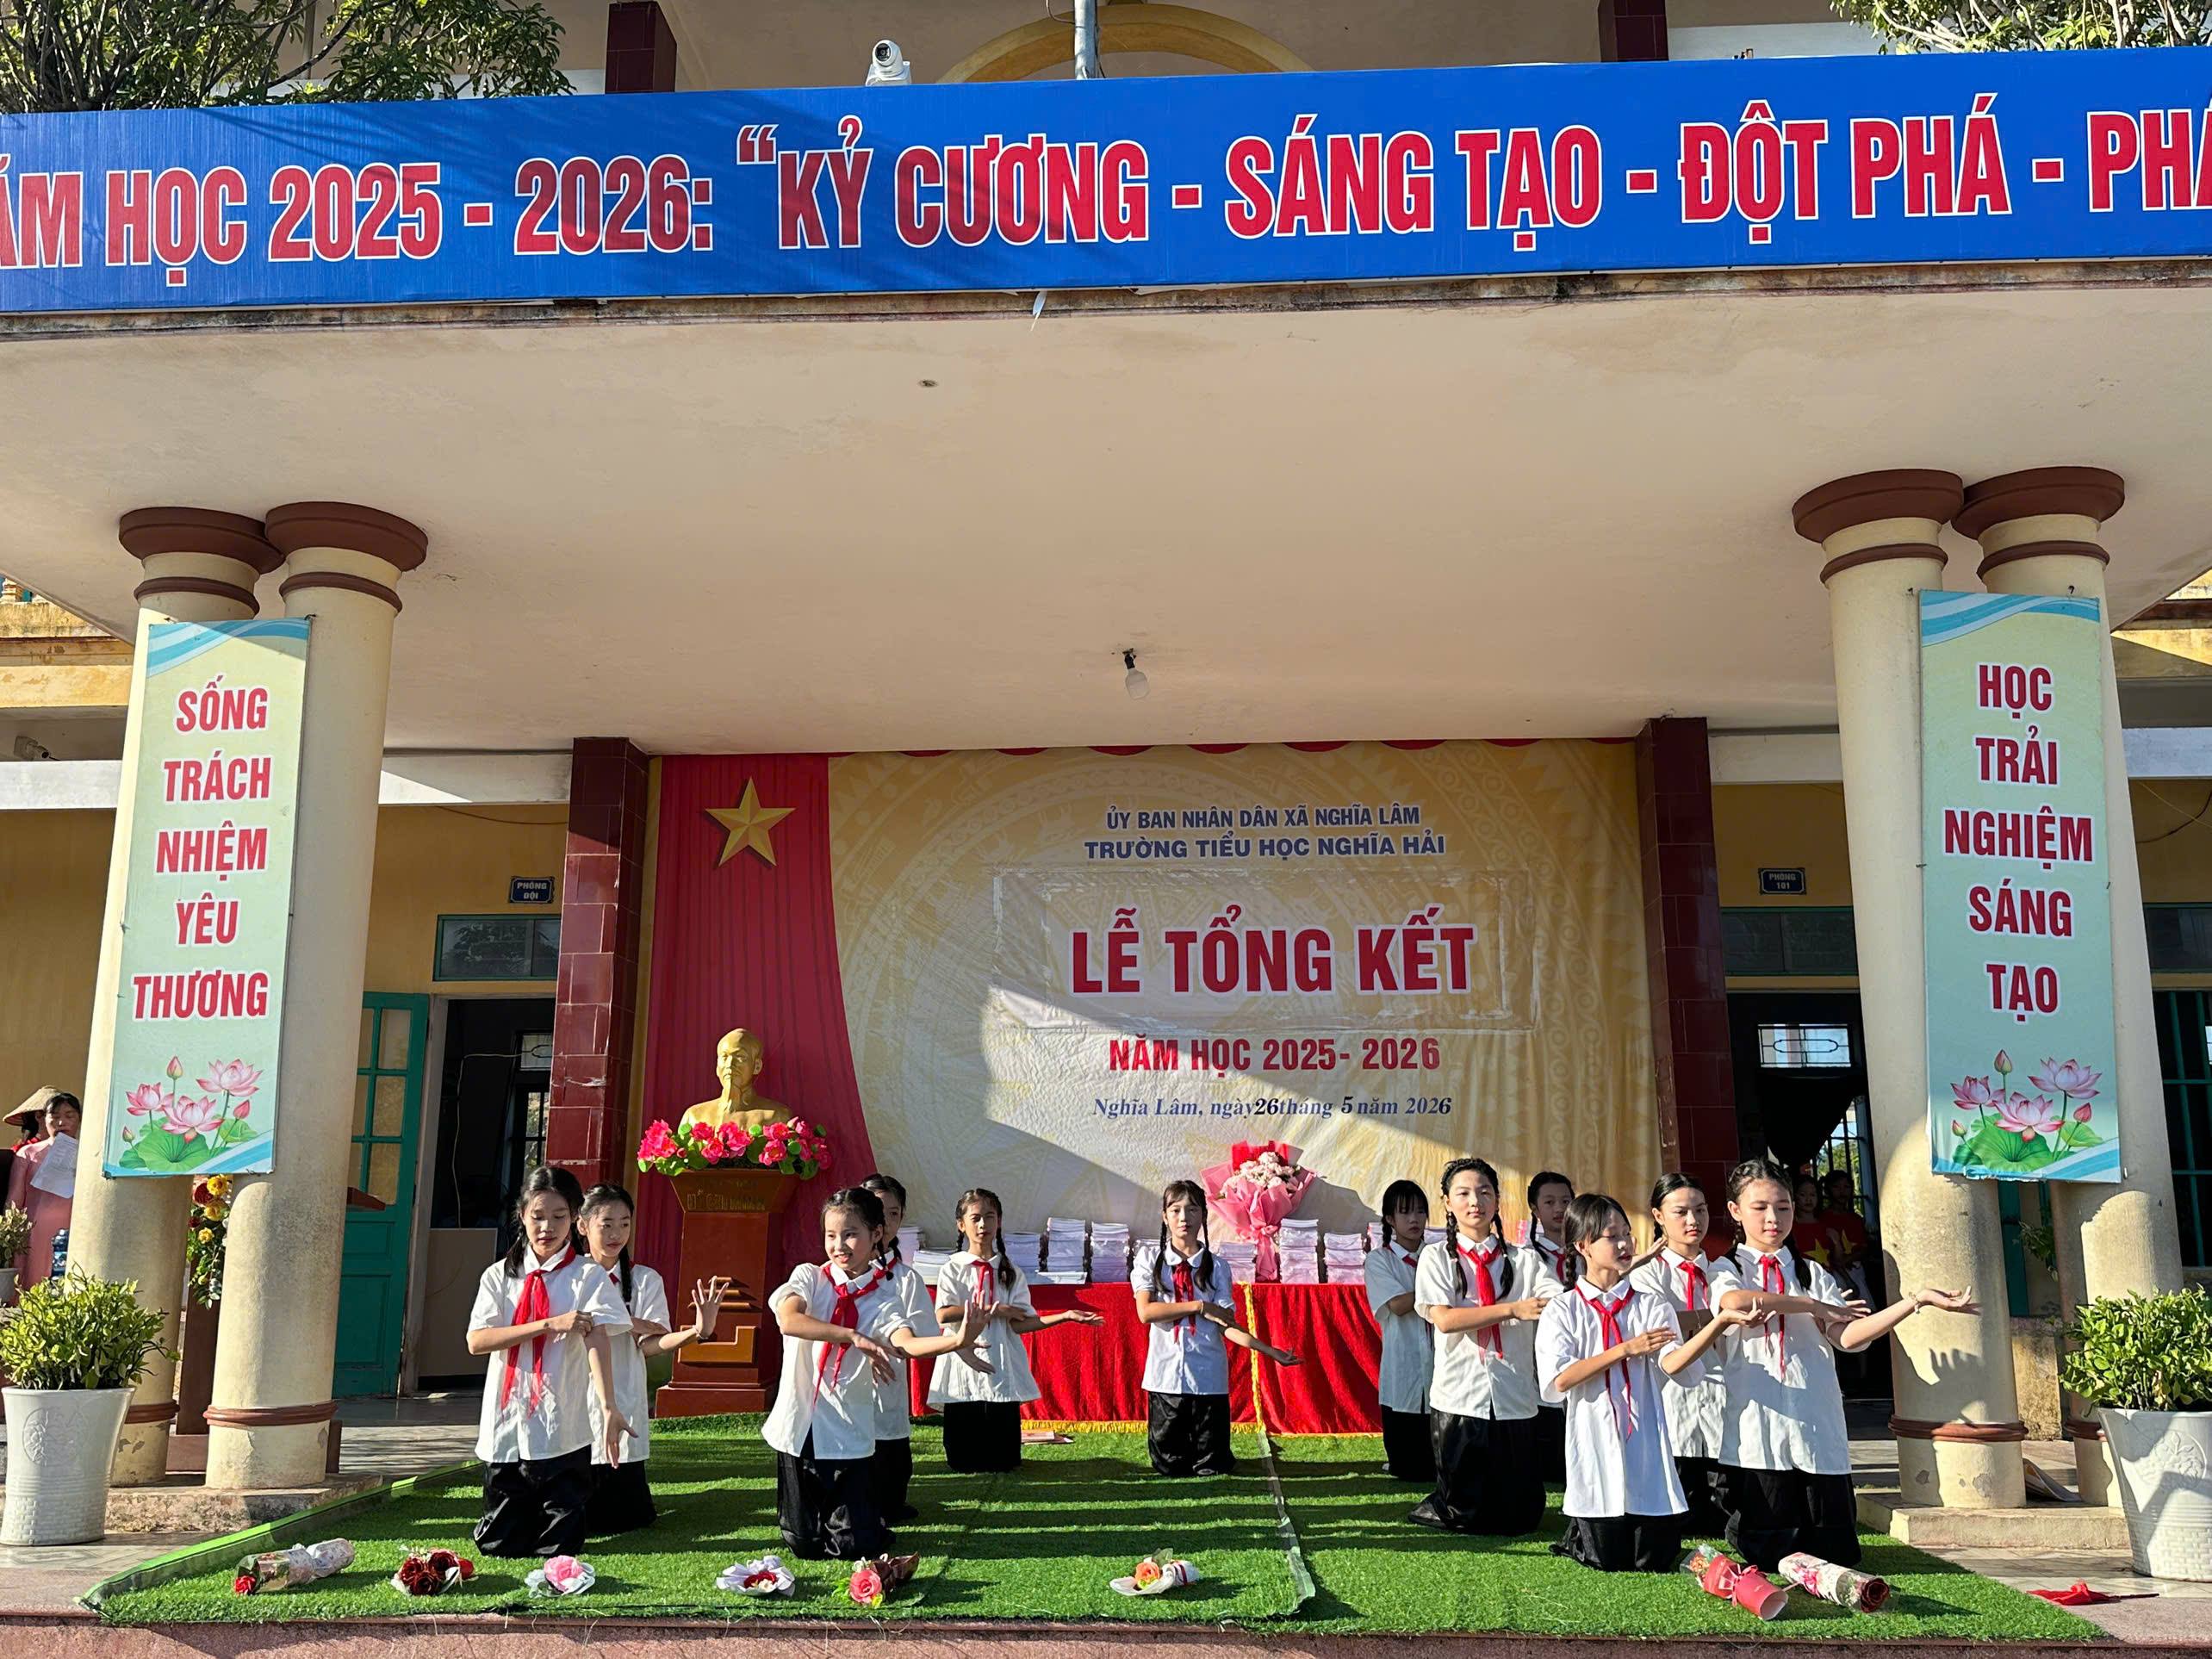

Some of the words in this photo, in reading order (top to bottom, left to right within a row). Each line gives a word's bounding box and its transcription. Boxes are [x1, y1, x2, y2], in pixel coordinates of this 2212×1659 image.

[105, 166, 247, 288] HỌC
[268, 162, 442, 262] 2025
[463, 202, 494, 227] -
[513, 155, 713, 256] 2026:
[895, 134, 1149, 249] CƯƠNG
[1171, 183, 1202, 209] -
[1225, 113, 1435, 240] SÁNG
[1455, 124, 1603, 252] TẠO
[1625, 169, 1658, 194] -
[1677, 99, 1828, 245] ĐỘT
[1850, 92, 2012, 219] PHÁ
[2032, 158, 2064, 183] -
[176, 674, 268, 731] SỐNG
[1978, 664, 2053, 720] HỌC
[164, 750, 270, 802] TRÁCH
[1975, 725, 2059, 786] TRẢI
[1107, 805, 1130, 830] ỦY
[1139, 811, 1175, 828] BAN
[1182, 805, 1233, 827] NHÂN
[1240, 805, 1277, 827] DÂN
[1284, 805, 1308, 826] XÃ
[1315, 804, 1372, 826] NGHĨA
[1379, 803, 1420, 824] LÂM
[1943, 806, 2093, 870] NGHIỆM
[156, 820, 267, 882] NHIỆM
[1084, 836, 1187, 859] TRƯỜNG
[1196, 831, 1250, 857] TIỂU
[1258, 838, 1309, 861] HỌC
[1318, 833, 1395, 855] NGHĨA
[1403, 830, 1445, 854] HẢI
[175, 892, 239, 945] YÊU
[1968, 878, 2073, 937] SÁNG
[1073, 907, 1140, 993] LỄ
[1165, 904, 1332, 992] TỔNG
[1358, 907, 1473, 991] KẾT
[133, 970, 268, 1019] THƯƠNG
[1986, 964, 2059, 1022] TẠO
[1109, 1034, 1178, 1071] NĂM
[1191, 1039, 1250, 1078] HỌC
[1362, 1038, 1440, 1070] 2026
[1093, 1098, 1148, 1119] Nghĩa
[1154, 1097, 1202, 1118] Lâm,
[1340, 1096, 1354, 1114] 5
[1358, 1098, 1398, 1115] năm
[1405, 1097, 1451, 1115] 2026
